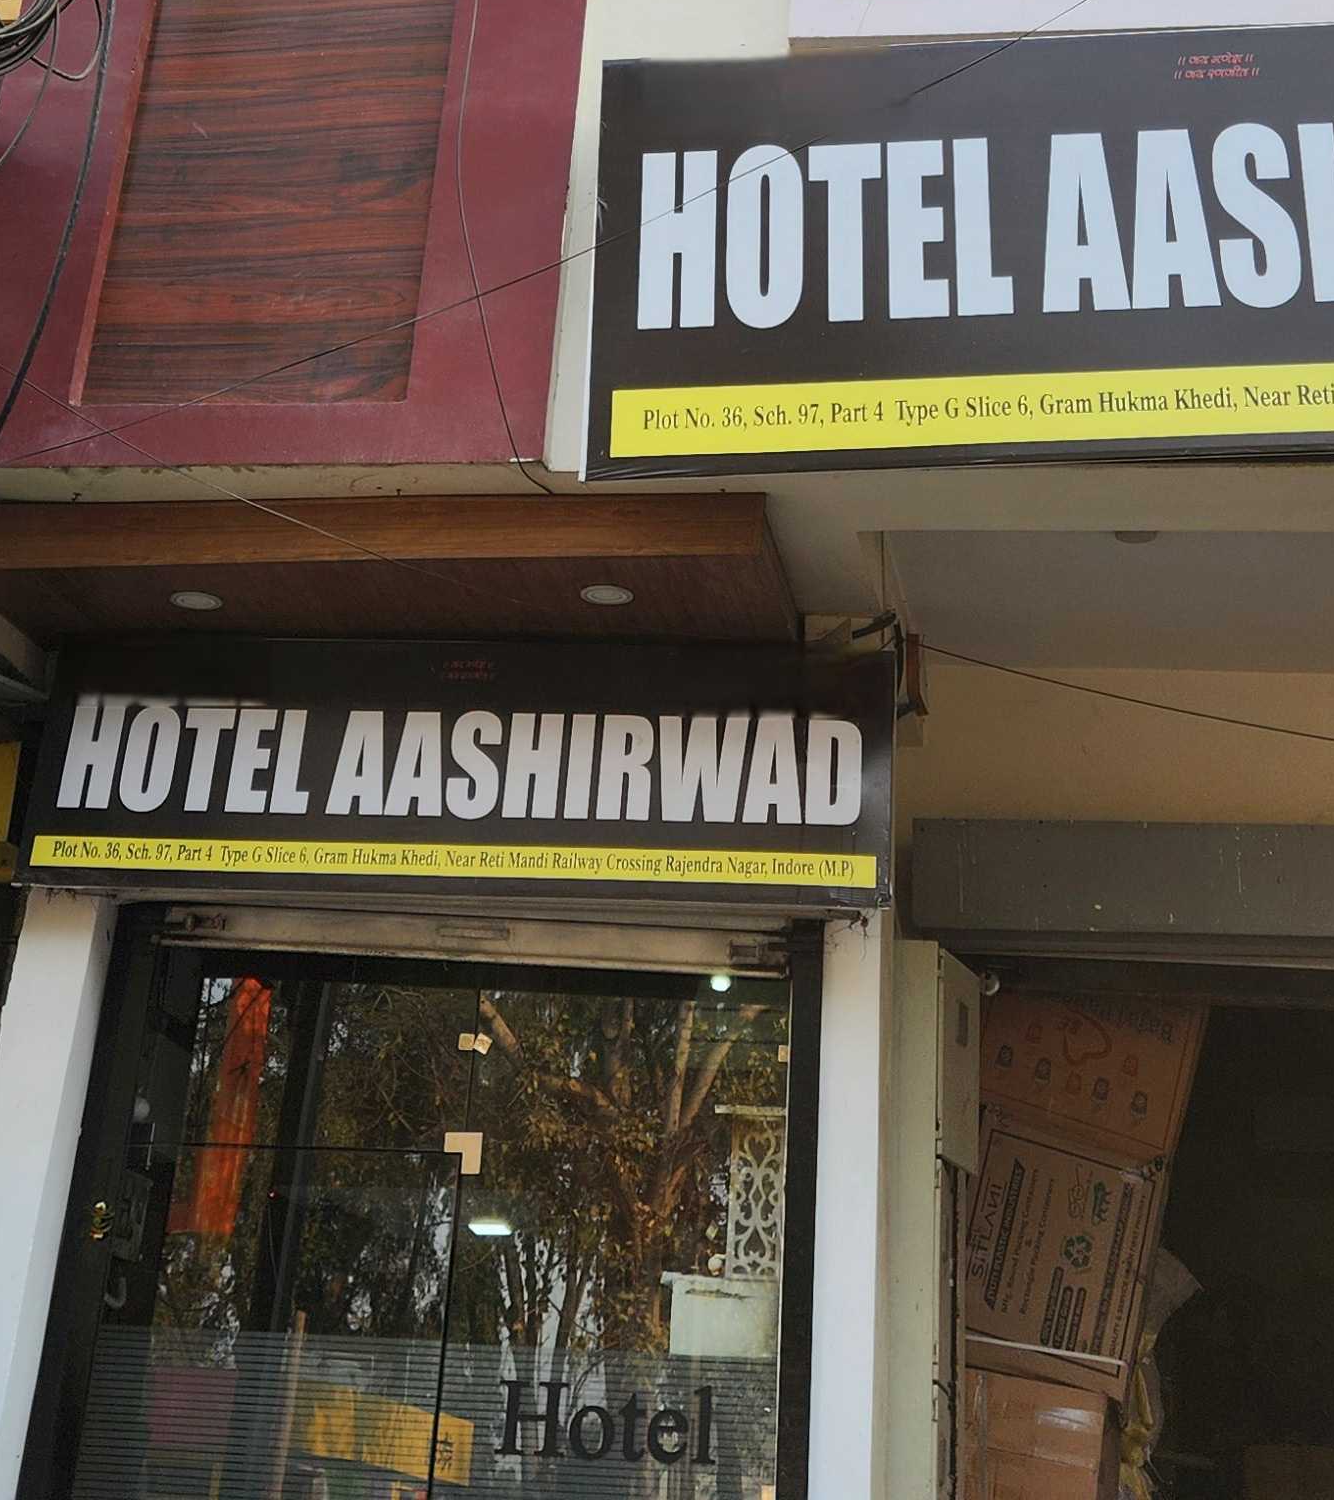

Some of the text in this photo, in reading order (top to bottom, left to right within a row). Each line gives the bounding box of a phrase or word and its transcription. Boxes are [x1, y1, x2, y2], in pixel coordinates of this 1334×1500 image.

[637, 137, 1014, 329] HOTEL
[643, 405, 678, 431] Plot
[685, 406, 716, 429] No.
[722, 405, 749, 432] 36,
[753, 402, 792, 429] Sch.
[797, 402, 825, 429] 97,
[829, 401, 867, 425] Part
[873, 402, 884, 422] 4
[894, 398, 940, 427] Type
[945, 397, 960, 421] G
[965, 395, 1012, 420] Slice
[1017, 396, 1034, 421] 6,
[1038, 393, 1093, 417] Gram
[1098, 389, 1169, 414] Hukma
[1173, 386, 1238, 414] Khedi,
[1244, 386, 1292, 410] Near
[1297, 382, 1334, 406] Reti
[56, 697, 863, 826] HOTEL AASHIRWAD
[51, 841, 78, 859] Plot
[79, 841, 102, 860] No.
[104, 842, 123, 862] 36,
[125, 842, 153, 861] Sch.
[155, 844, 173, 863] 97,
[176, 845, 203, 862] Part
[205, 846, 213, 861] 4
[220, 845, 249, 868] Type
[251, 846, 264, 864] G
[265, 845, 296, 864] Slice
[299, 847, 310, 866] 6,
[313, 847, 348, 865] Gram
[351, 847, 396, 866] Hukma
[400, 848, 441, 868] Khedi,
[444, 850, 476, 868] Near
[479, 850, 506, 868] Reti
[509, 850, 549, 870] Mandi
[552, 851, 603, 875] Railway
[606, 852, 663, 876] Crossing
[666, 854, 723, 877] Rajendra
[725, 856, 768, 880] Nagar,
[772, 857, 816, 877] Indore
[500, 1379, 716, 1466] Hotel
